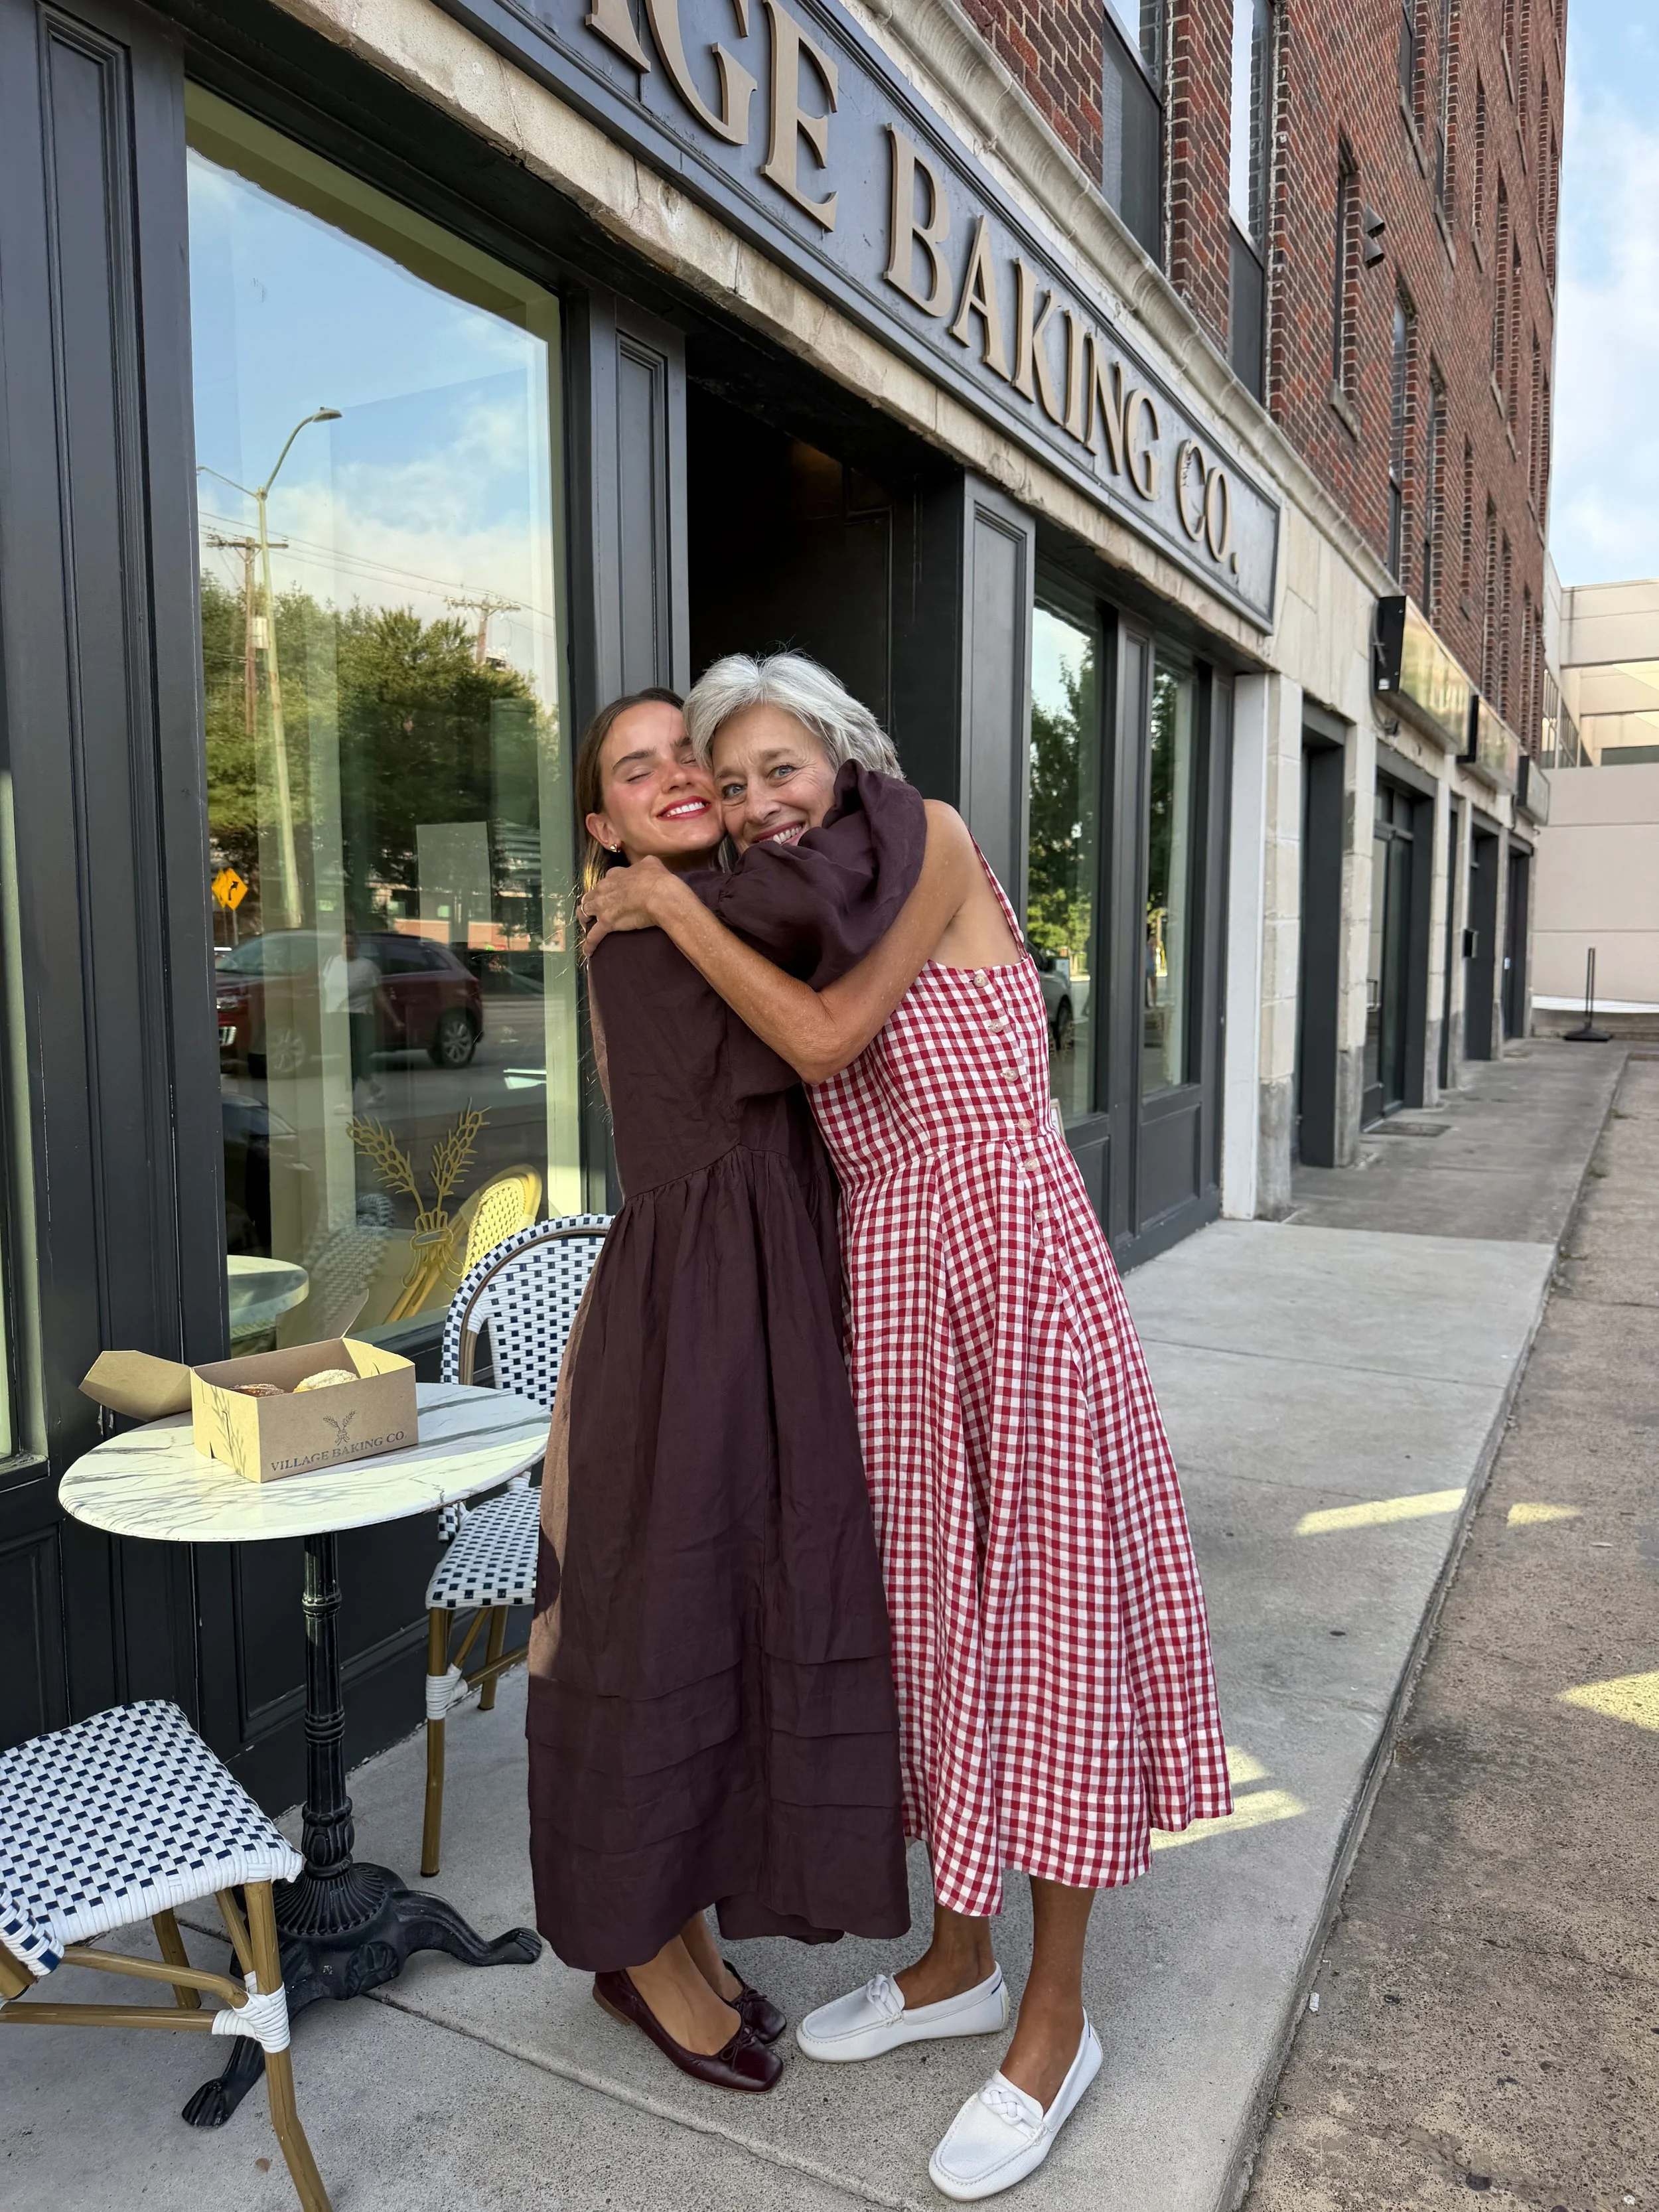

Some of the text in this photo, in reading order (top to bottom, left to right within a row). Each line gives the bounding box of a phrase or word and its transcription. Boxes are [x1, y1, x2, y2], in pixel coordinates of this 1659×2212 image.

[883, 123, 1160, 502] BAKING
[1177, 439, 1238, 575] CO.
[271, 1431, 407, 1471] VILLAGE BAKING CO.
